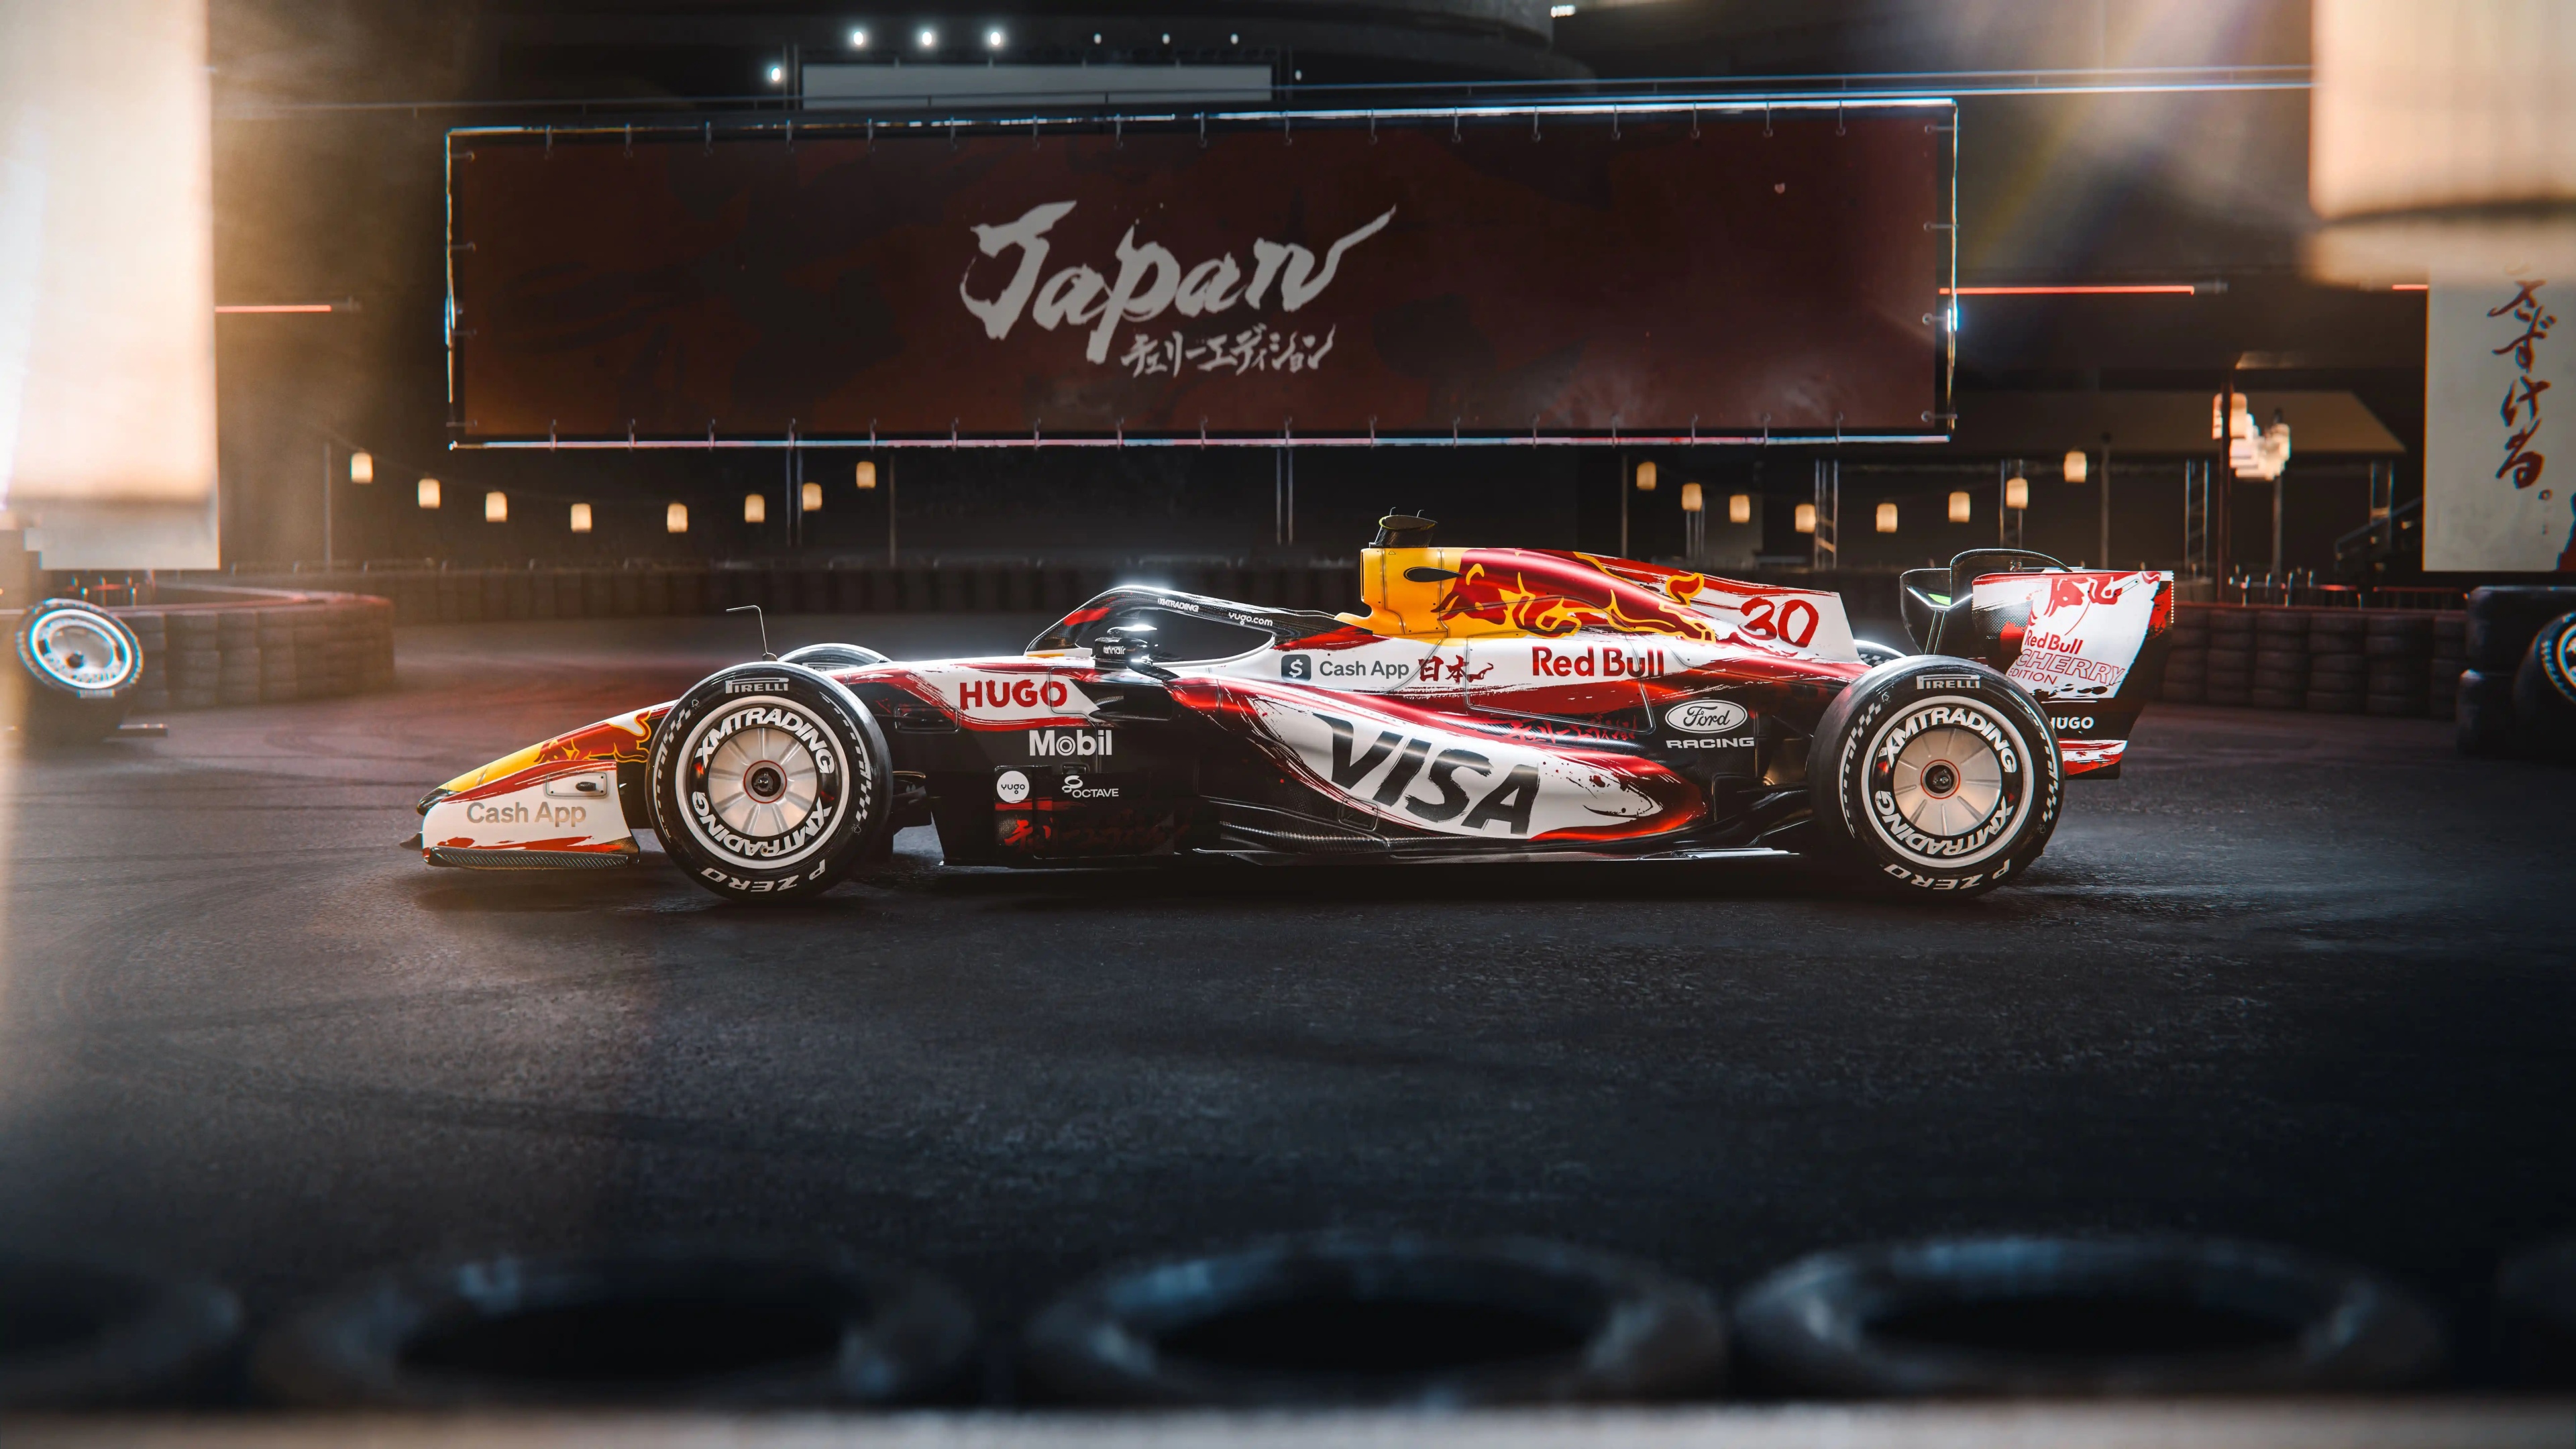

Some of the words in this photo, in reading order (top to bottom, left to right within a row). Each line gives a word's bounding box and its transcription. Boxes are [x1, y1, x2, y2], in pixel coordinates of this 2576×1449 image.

[961, 201, 1396, 364] Japan
[1120, 323, 1336, 378] チェリーエディション
[2487, 263, 2557, 500] さずける。
[1228, 612, 1273, 626] yugo.com
[1740, 597, 1819, 648] 30
[2025, 629, 2049, 649] Red
[2047, 634, 2083, 654] Bull
[1320, 661, 1365, 676] Cash
[1371, 661, 1409, 679] App
[1418, 655, 1494, 684] 日本
[1532, 647, 1594, 676] Red
[1603, 647, 1664, 677] Bull
[2016, 649, 2125, 686] CHERRY
[725, 678, 789, 694] PIRELLI
[1917, 676, 1980, 690] PIRELLI
[2009, 668, 2057, 685] EDITION
[959, 680, 1067, 710] HUGO
[1684, 706, 1730, 727] Ford
[695, 708, 835, 773] XMTRADING
[1029, 730, 1112, 756] Mobil
[1666, 737, 1754, 749] RACING
[1878, 707, 2017, 773] XMTRADING
[1311, 711, 1540, 835] VISA
[1001, 784, 1025, 794] yugo
[1072, 788, 1119, 798] OCTAVE
[467, 804, 528, 824] Cash
[535, 804, 586, 826] App
[692, 792, 832, 857] XMTRADING
[1875, 790, 2014, 856] XMTRADING
[701, 867, 799, 892] ZERO
[809, 859, 825, 880] P
[1884, 864, 1983, 890] ZERO
[1992, 859, 2010, 879] P
